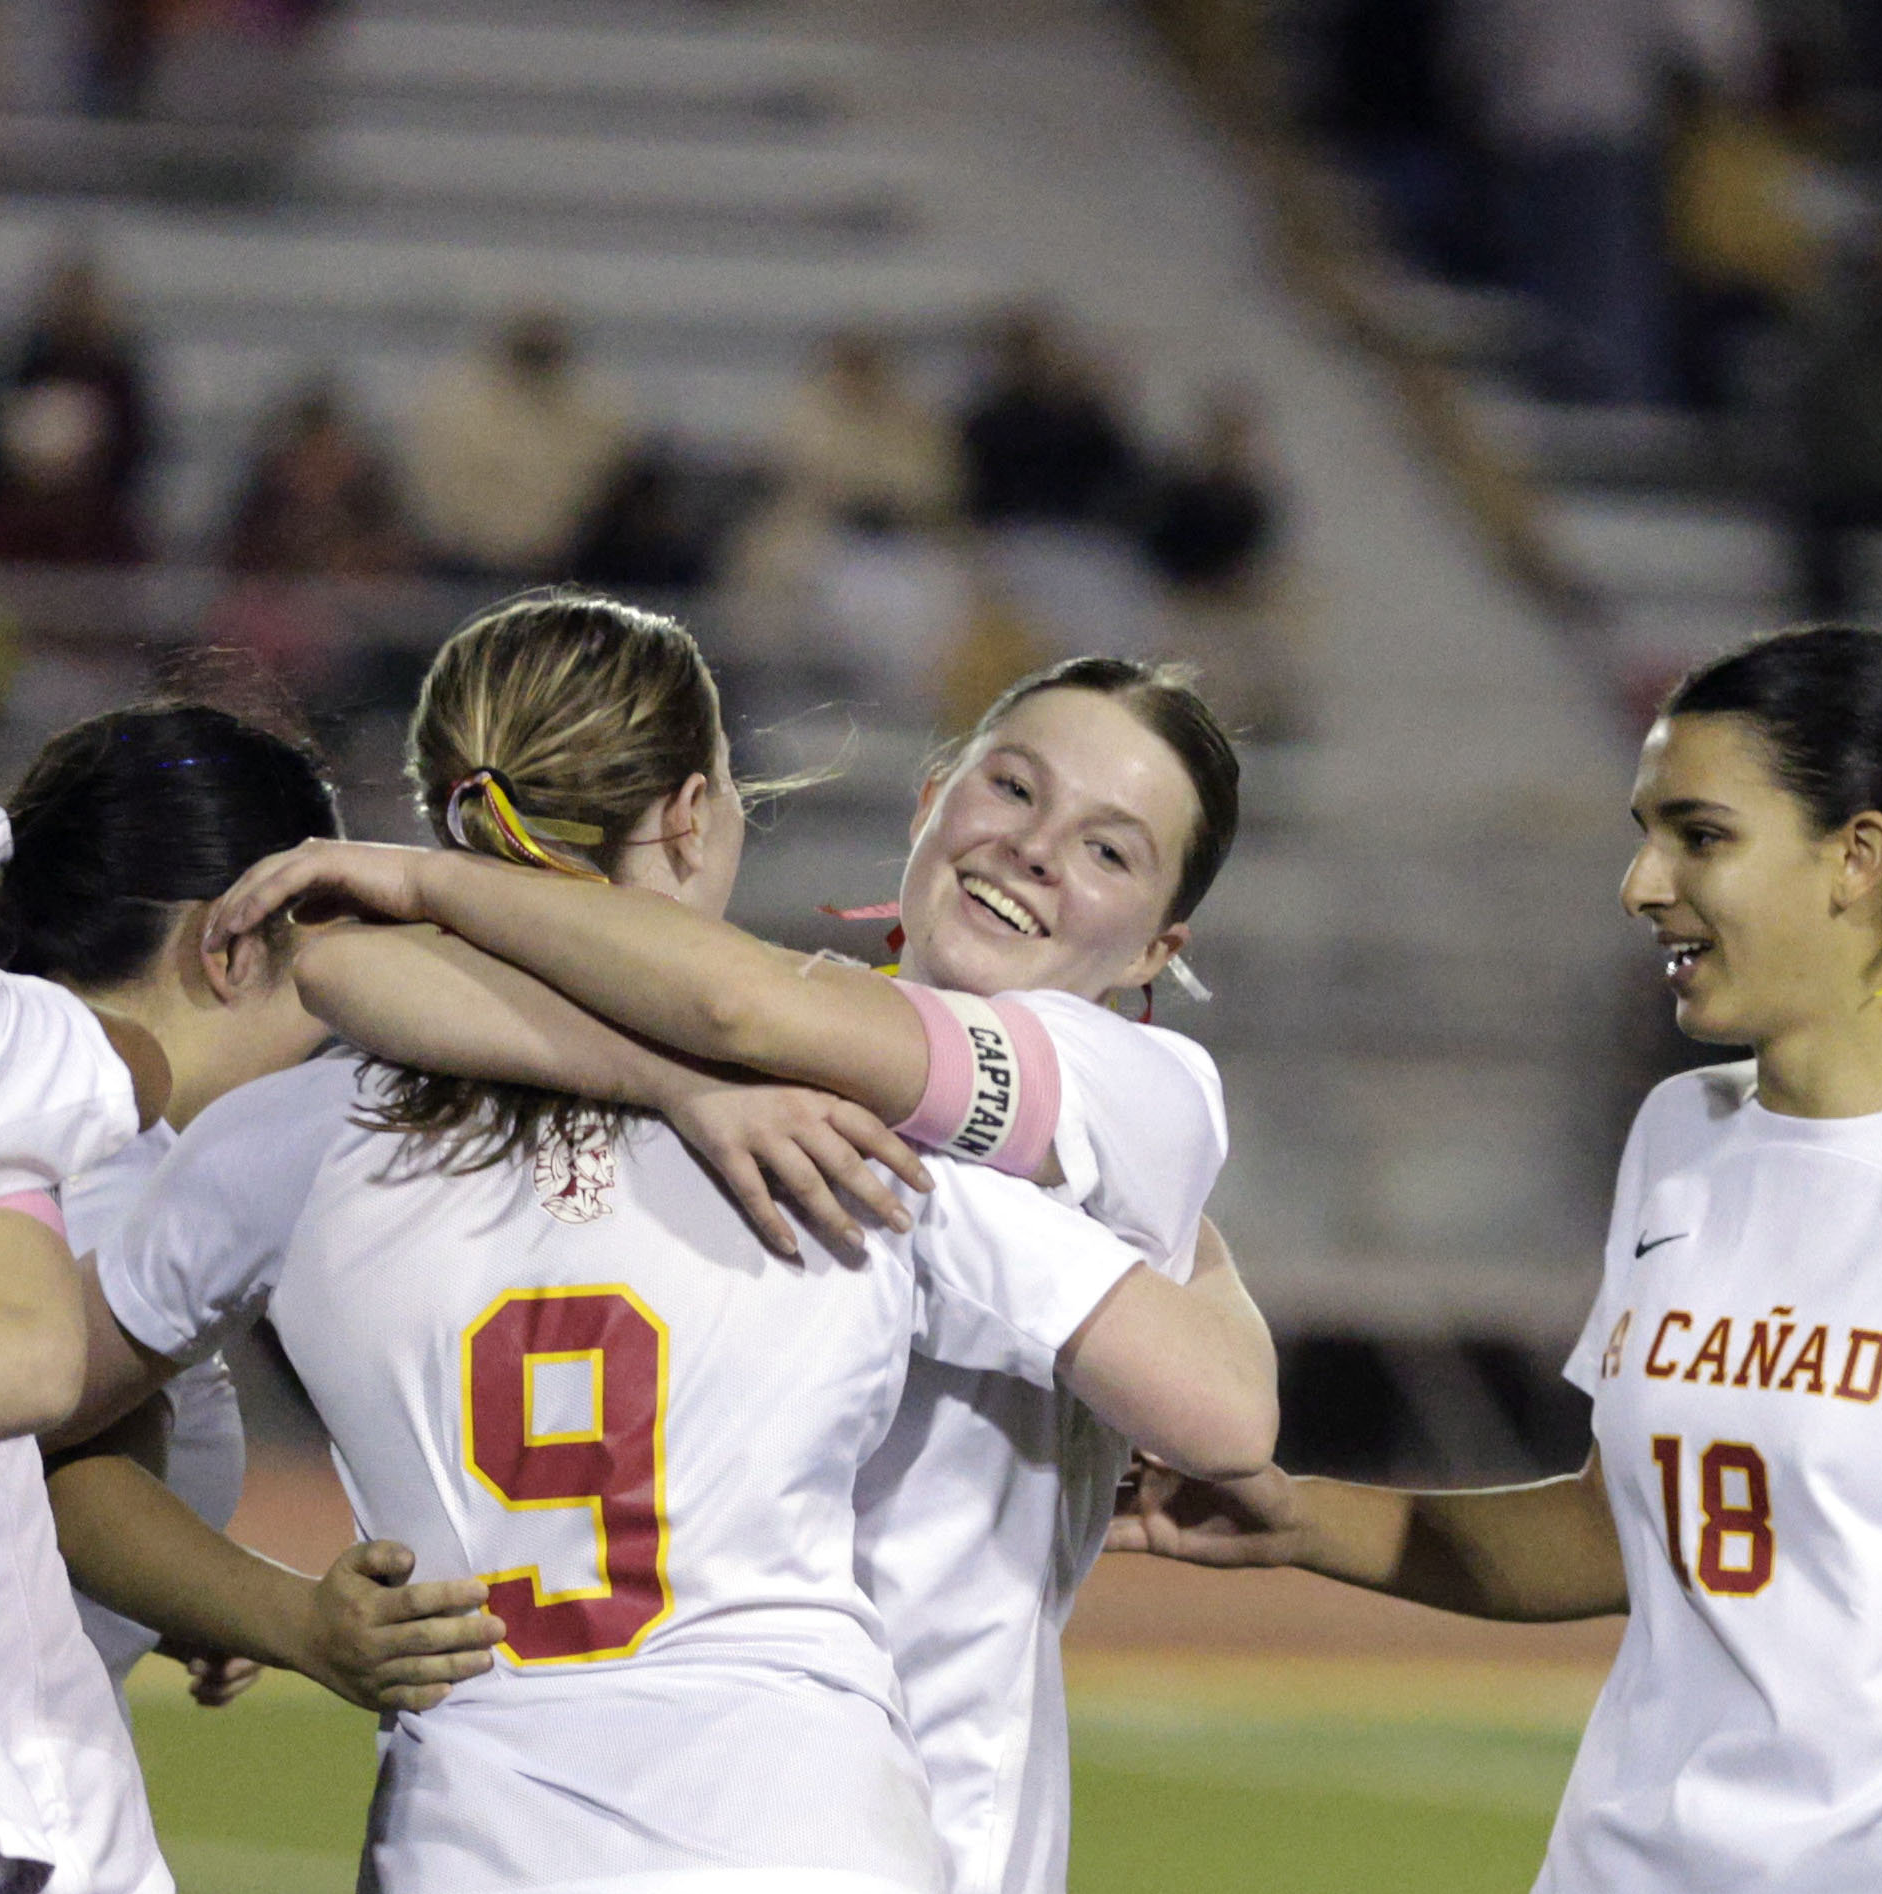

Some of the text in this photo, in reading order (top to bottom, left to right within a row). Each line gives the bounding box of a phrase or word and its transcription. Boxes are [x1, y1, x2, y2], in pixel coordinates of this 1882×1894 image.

[952, 1025, 1012, 1157] CAPTAIN
[1600, 1306, 1638, 1380] A
[460, 1282, 675, 1667] 9
[1650, 1434, 1775, 1599] 18
